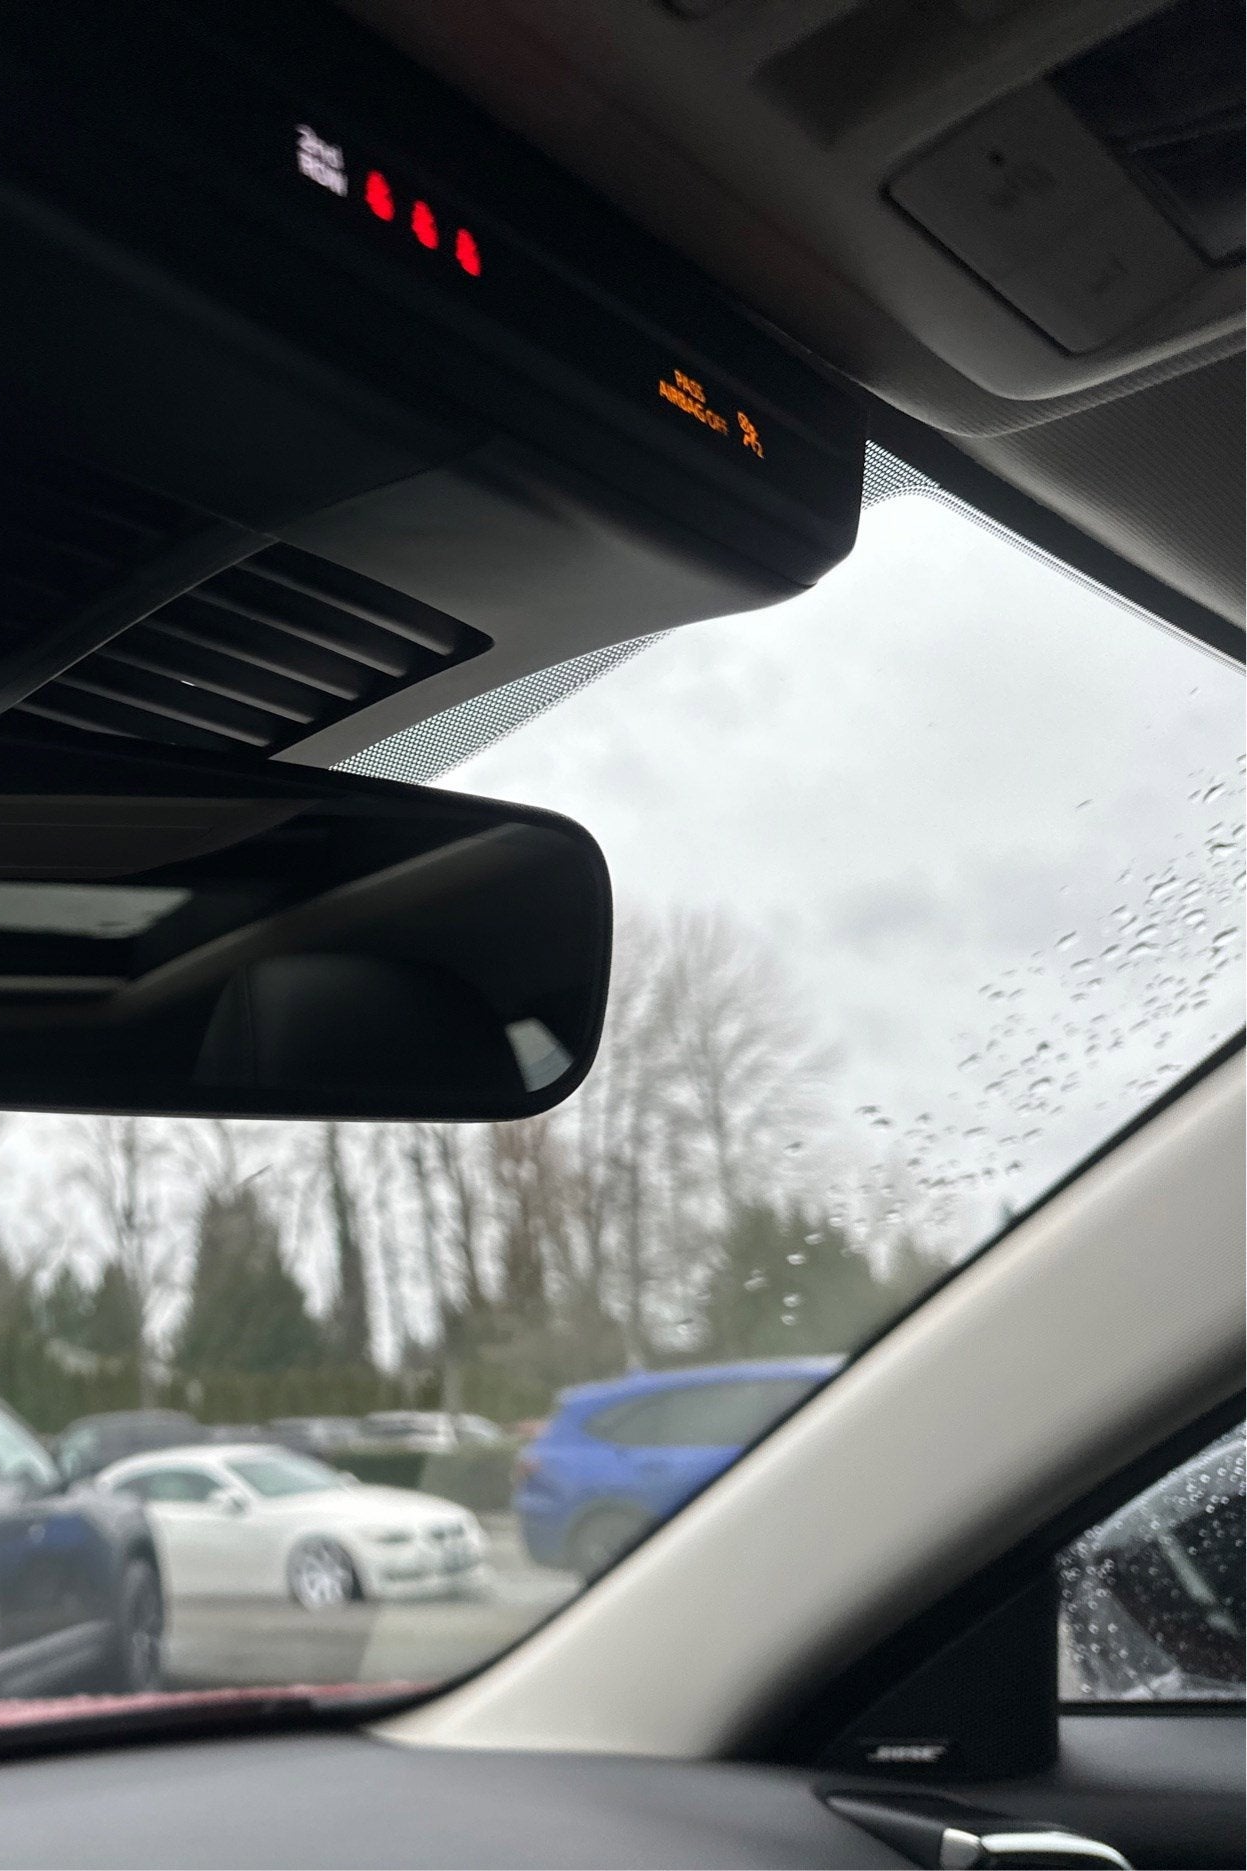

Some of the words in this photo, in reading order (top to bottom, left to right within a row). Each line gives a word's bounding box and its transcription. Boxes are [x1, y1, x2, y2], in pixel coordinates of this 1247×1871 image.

[659, 379, 707, 424] AIRBAG
[705, 409, 728, 434] OFF
[674, 369, 706, 404] PASS
